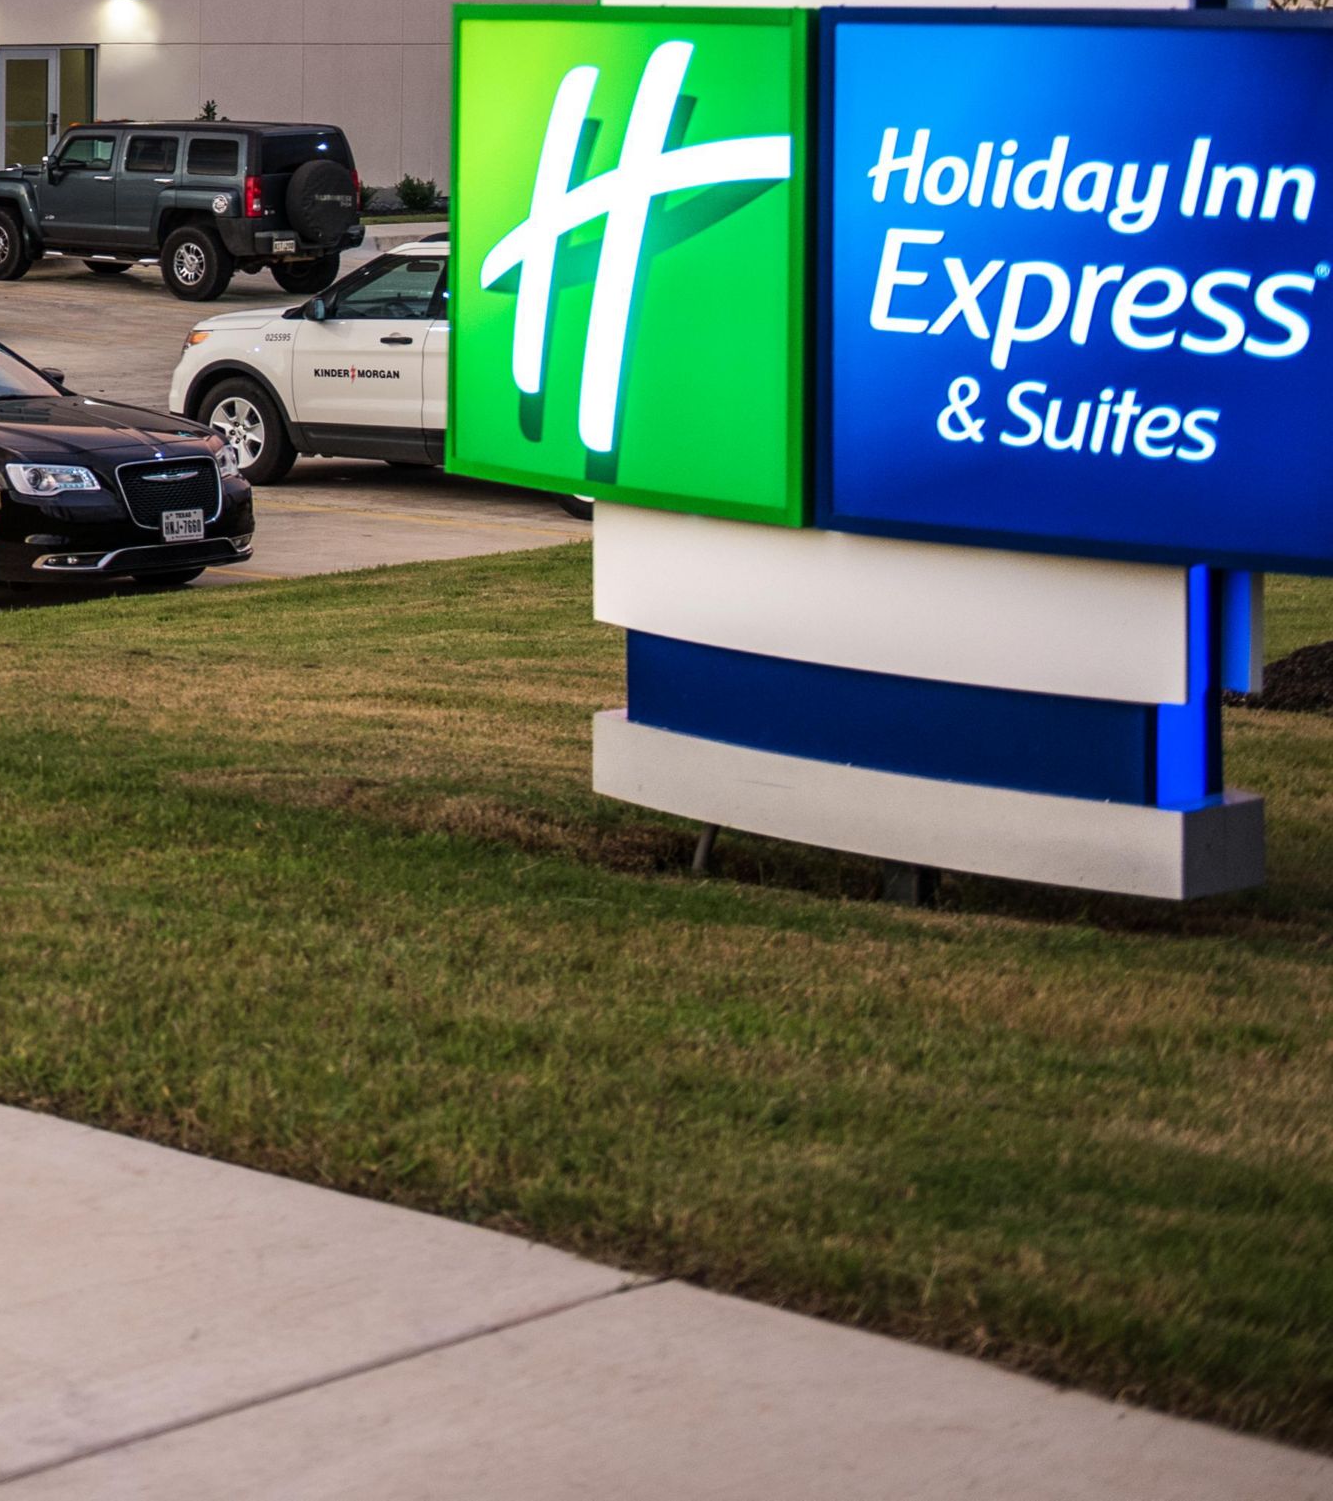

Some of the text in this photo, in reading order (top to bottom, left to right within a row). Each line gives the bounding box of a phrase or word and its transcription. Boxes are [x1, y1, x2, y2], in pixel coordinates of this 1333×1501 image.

[867, 127, 1317, 234] Holiday Inn
[265, 333, 291, 341] 025595
[314, 368, 400, 379] KINDER MORGAN
[936, 376, 1221, 462] & Suites
